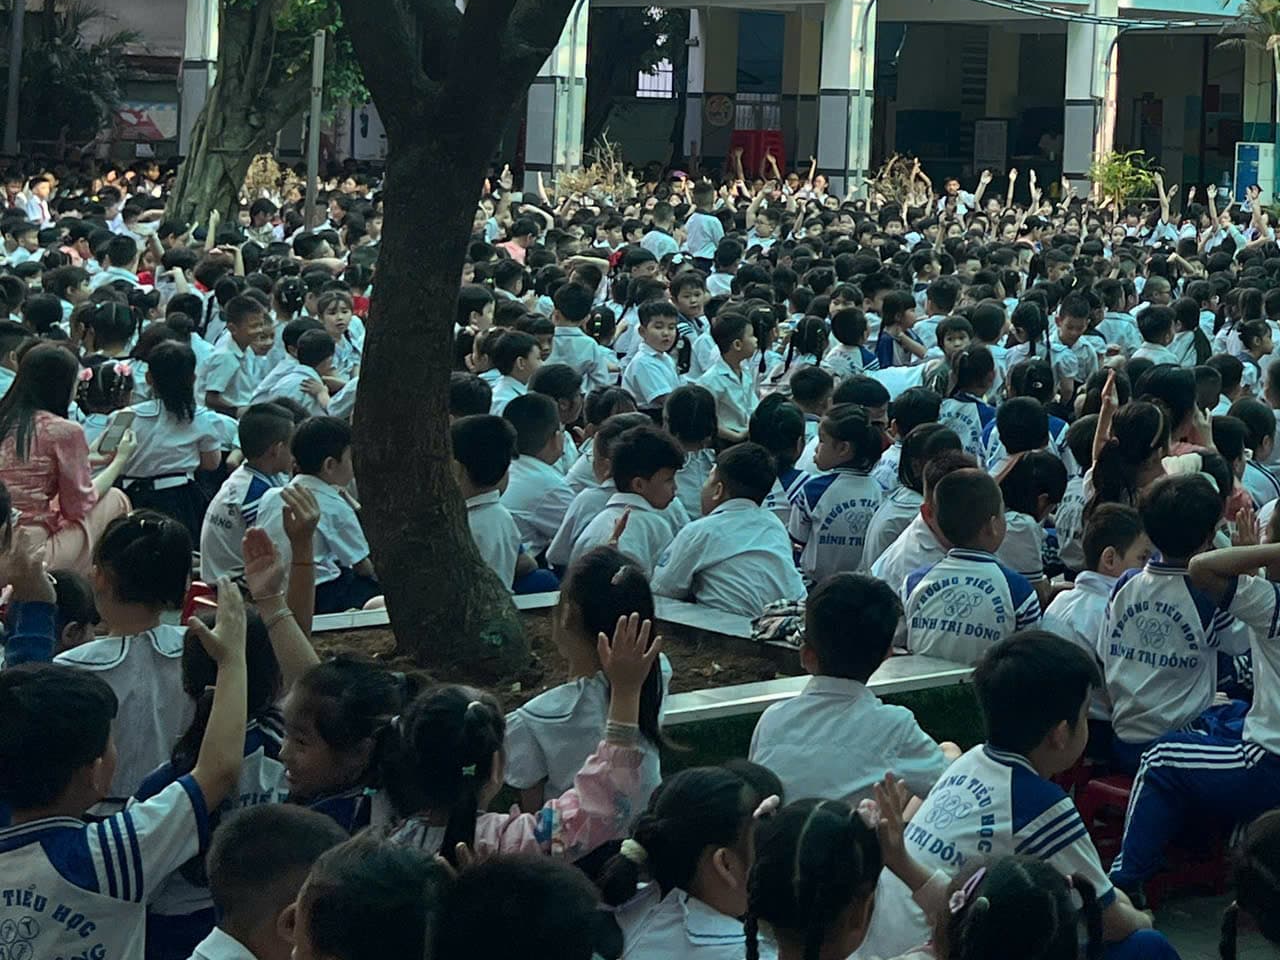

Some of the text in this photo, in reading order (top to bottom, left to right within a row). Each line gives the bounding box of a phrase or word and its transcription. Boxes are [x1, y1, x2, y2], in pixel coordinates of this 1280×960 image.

[940, 620, 962, 636] TRỊ
[964, 622, 1000, 641] ĐÔNG
[976, 814, 995, 853] HỌC
[928, 838, 968, 867] ĐÔN
[2, 884, 97, 938] TIỂU HỌC
